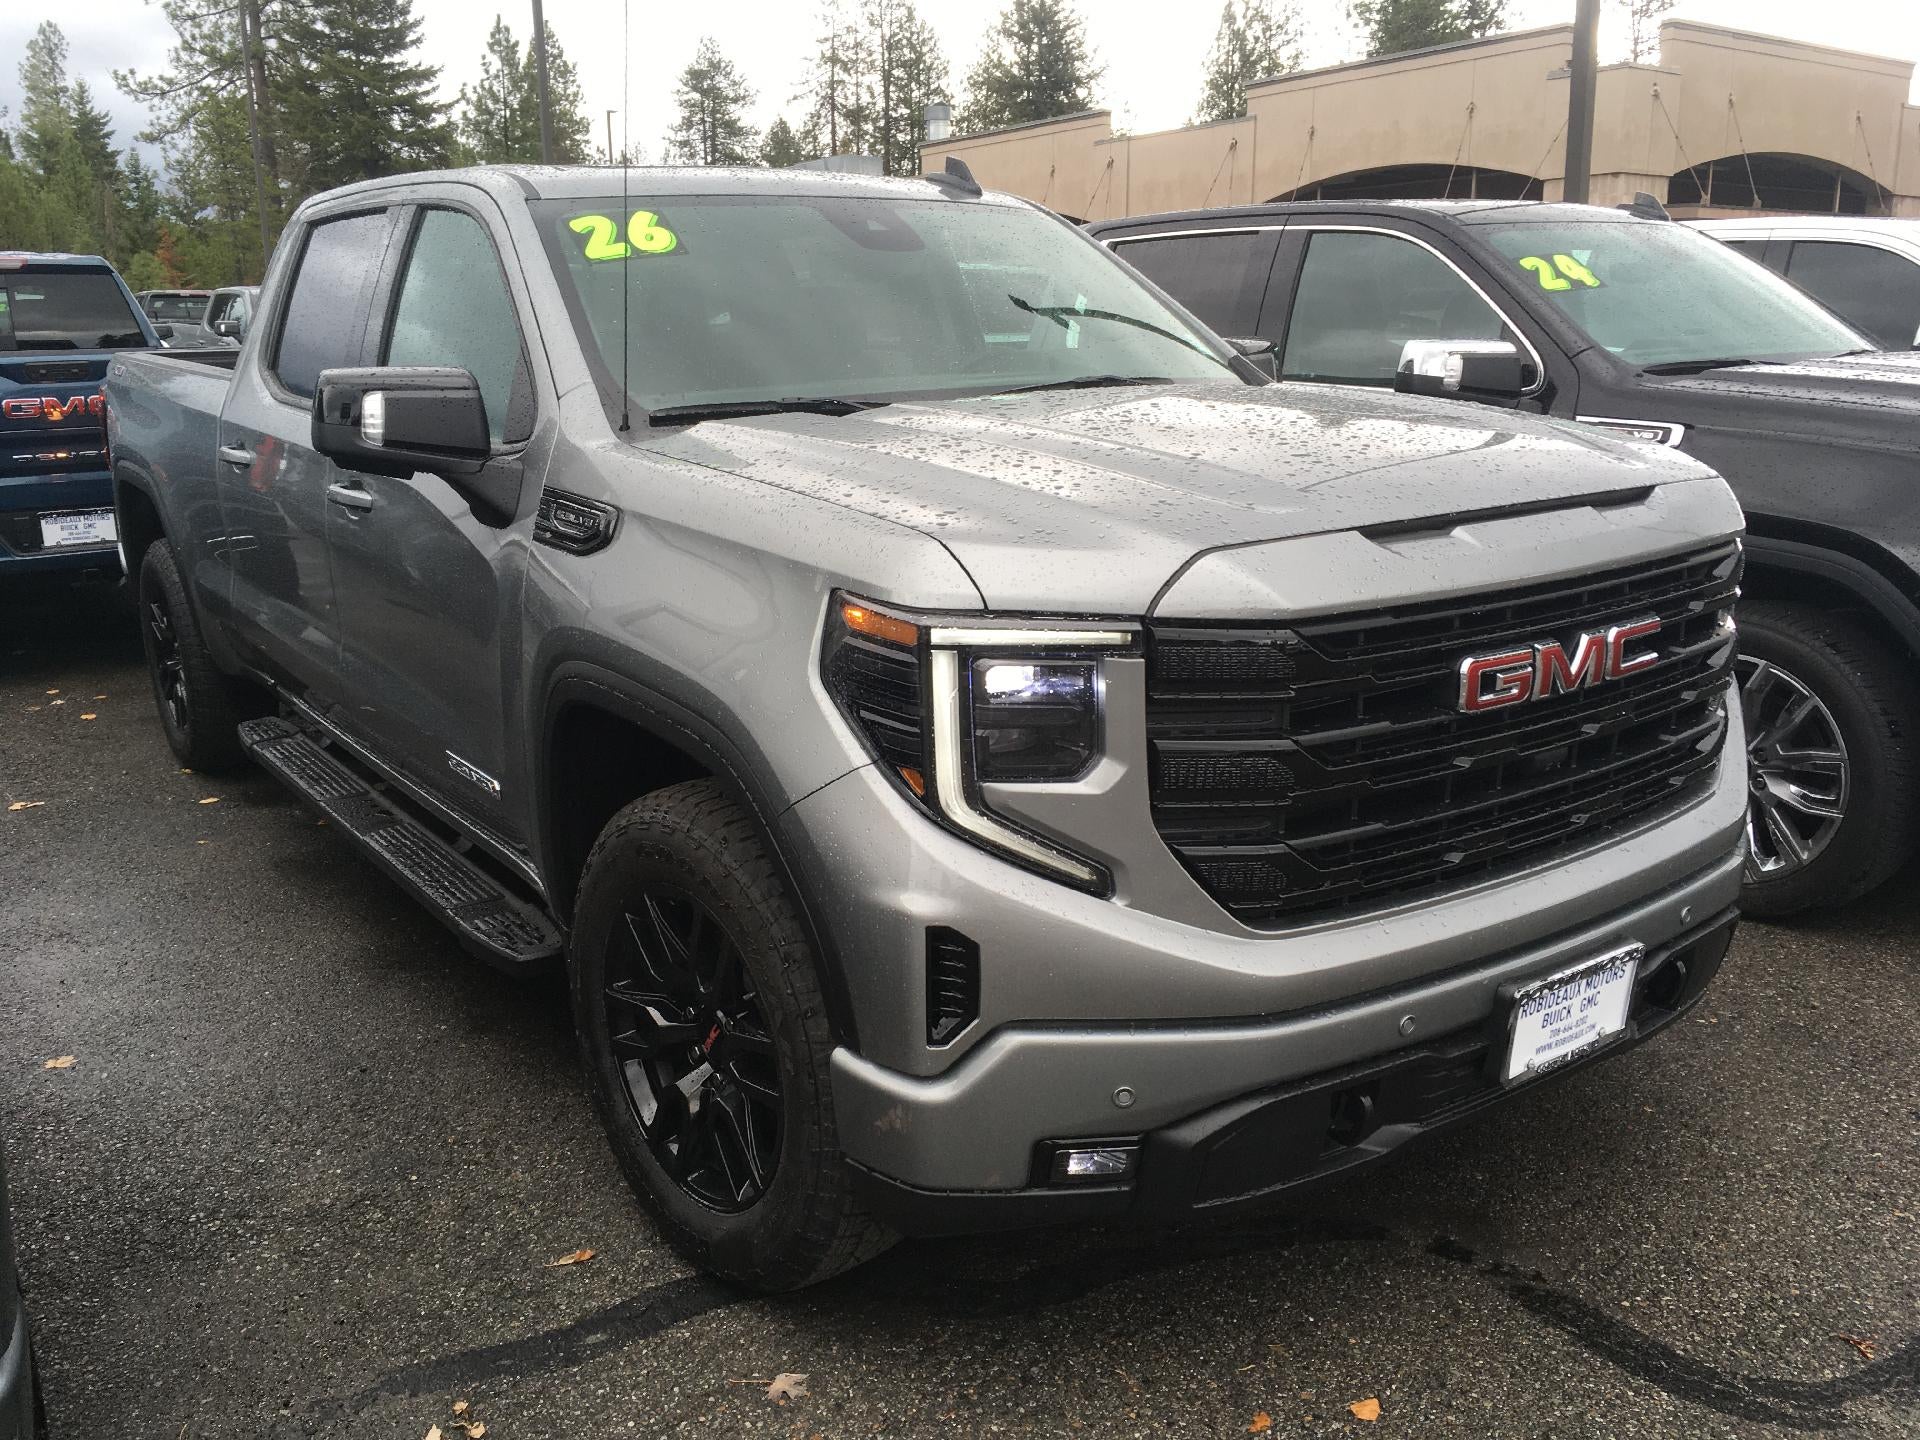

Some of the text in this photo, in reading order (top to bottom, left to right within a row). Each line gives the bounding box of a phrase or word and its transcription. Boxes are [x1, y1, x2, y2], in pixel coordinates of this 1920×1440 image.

[569, 211, 677, 260] 26
[1519, 254, 1600, 289] 24
[45, 513, 110, 526] ROBIDEAUX MOTORS
[1459, 615, 1661, 713] GMC
[1520, 964, 1627, 1019] ROBIDEAUX MOTORS
[1541, 990, 1601, 1029] BUICK GMC
